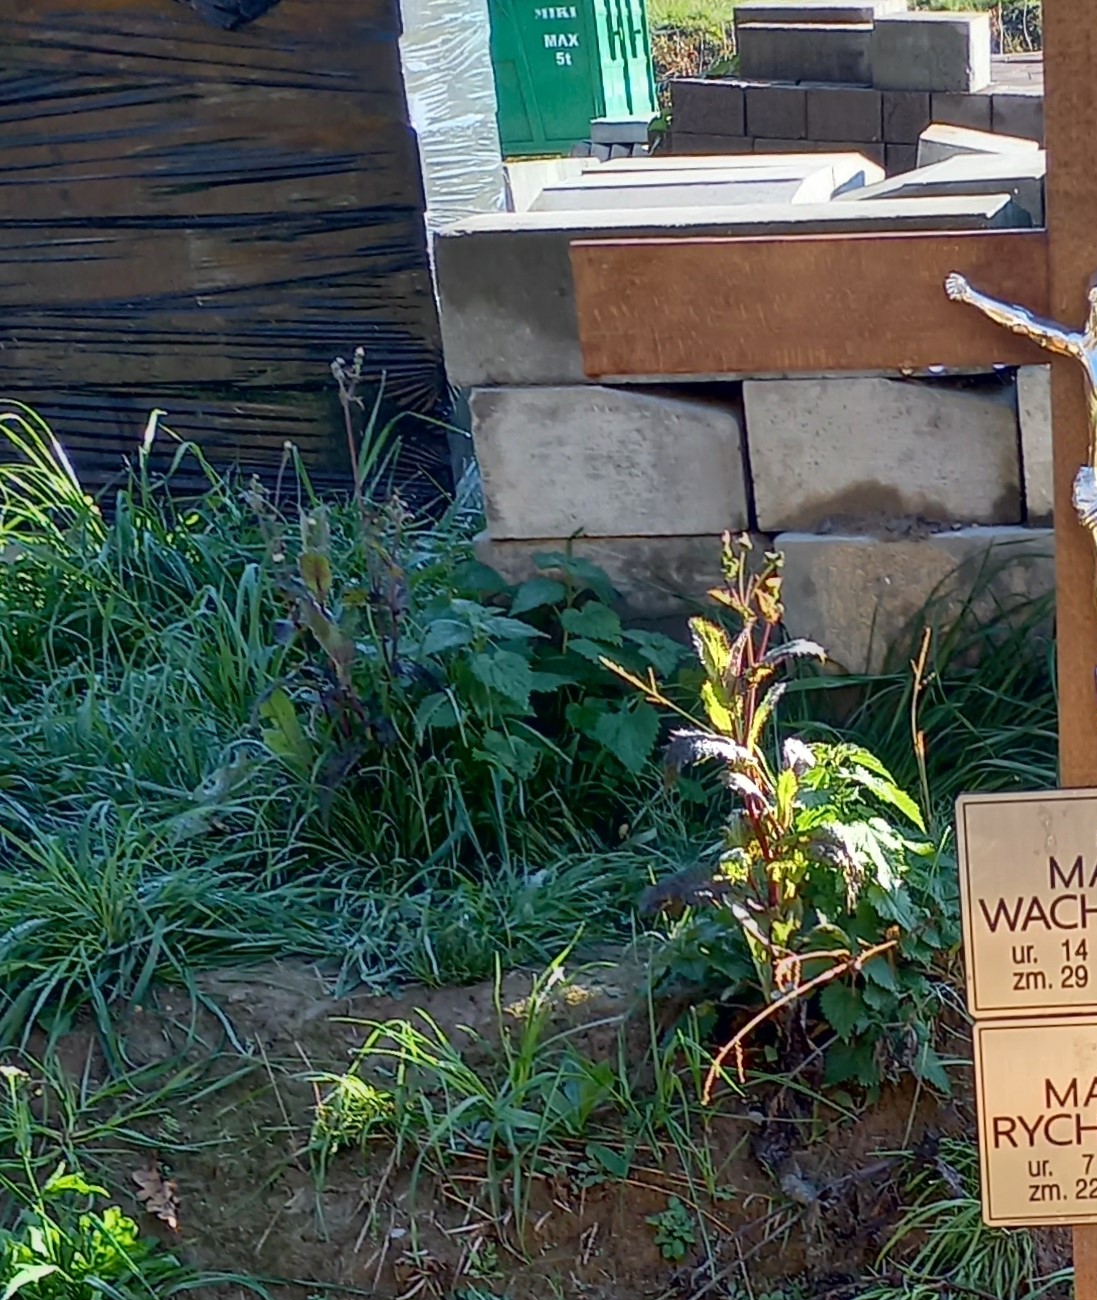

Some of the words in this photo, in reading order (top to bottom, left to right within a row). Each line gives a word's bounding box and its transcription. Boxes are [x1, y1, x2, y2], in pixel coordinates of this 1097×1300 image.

[544, 33, 579, 48] MAX
[556, 52, 572, 65] 5t
[1012, 945, 1038, 964] ur.
[1062, 938, 1088, 961] 14
[1013, 971, 1053, 990] zm.
[1061, 965, 1088, 988] 29
[1028, 1158, 1053, 1177] ur.
[1082, 1154, 1095, 1175] 7
[1029, 1183, 1067, 1201] zm.
